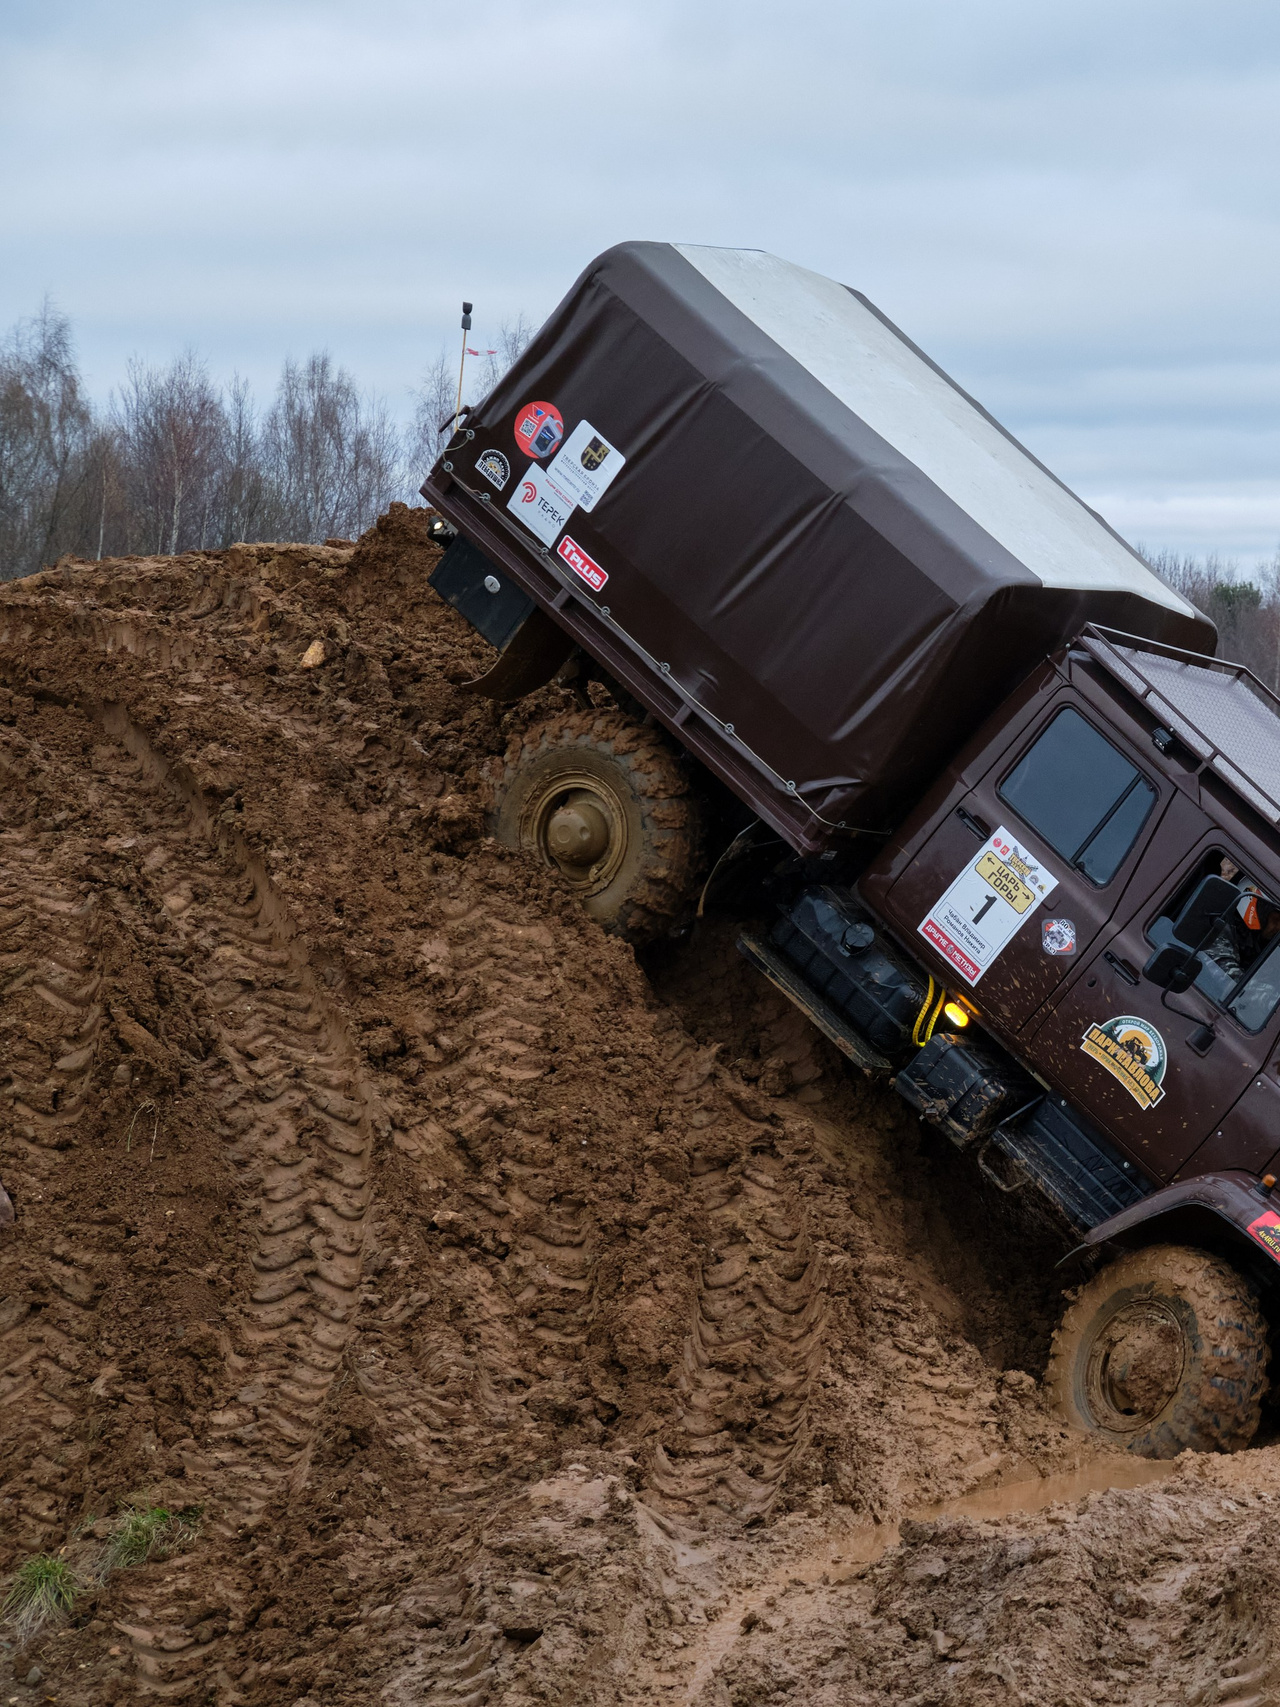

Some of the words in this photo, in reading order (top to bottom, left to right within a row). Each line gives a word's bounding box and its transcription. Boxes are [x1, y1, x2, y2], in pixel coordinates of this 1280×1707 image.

[537, 496, 564, 526] ТЕРЕК
[987, 871, 1017, 902] ГОРЫ
[995, 865, 1021, 891] ЦАРЬ
[971, 894, 997, 925] 1
[943, 915, 964, 937] Романов
[963, 936, 981, 954] Никита
[947, 908, 963, 925] Чабан
[961, 924, 986, 950] Владимир
[925, 923, 948, 947] ДРУГИЕ
[951, 950, 976, 976] МЕТИЗЫ
[1088, 1028, 1119, 1056] ПАРК
[1115, 1050, 1160, 1100] ПАВЛОВА
[1258, 1230, 1280, 1253] 4x4RU.ru
